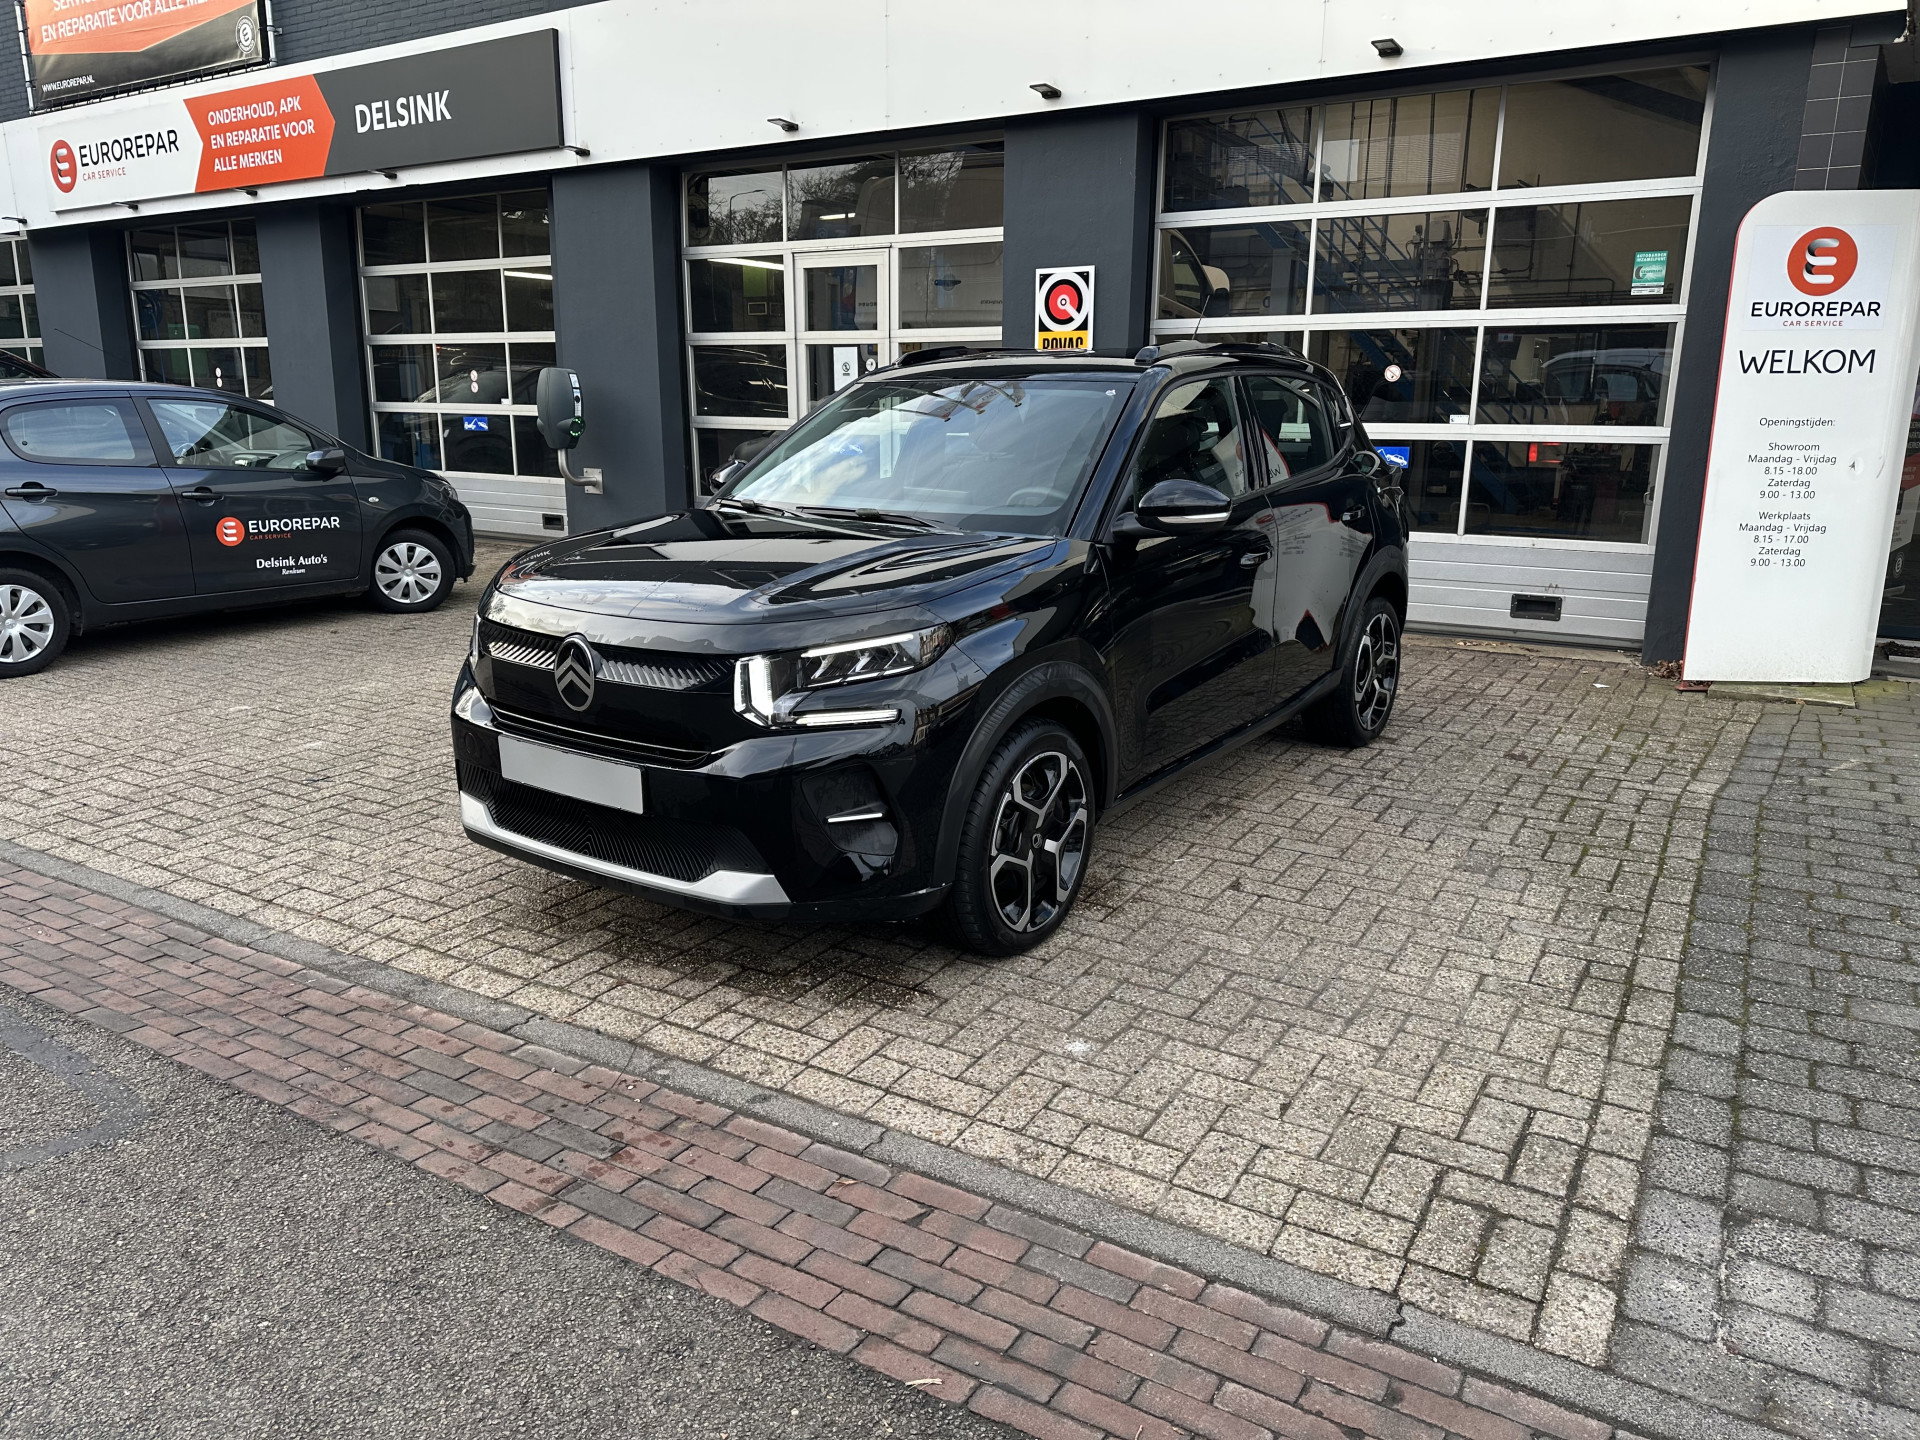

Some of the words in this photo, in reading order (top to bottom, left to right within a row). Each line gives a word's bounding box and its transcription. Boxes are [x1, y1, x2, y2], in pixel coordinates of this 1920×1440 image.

[42, 26, 58, 43] EN
[58, 9, 119, 40] REPARATIE
[119, 1, 151, 25] VOOR
[208, 101, 278, 126] ONDERHOUD,
[280, 95, 302, 114] APK
[354, 89, 452, 134] DELSINK
[210, 133, 225, 149] EN
[226, 124, 281, 147] REPARATIE
[282, 118, 316, 138] VOOR
[79, 129, 180, 167] EUROREPAR
[214, 155, 238, 172] ALLE
[239, 149, 283, 169] MERKEN
[82, 171, 96, 181] CAR
[98, 167, 127, 180] SERVICE
[1750, 301, 1881, 317] EUROREPAR
[1739, 349, 1876, 374] WELKOM
[1759, 417, 1836, 429] Openingstijden:
[1768, 442, 1820, 451] Showroom
[1747, 454, 1793, 465] Maandag
[1803, 454, 1837, 465] Vrijdag
[1764, 466, 1784, 475] 8.15
[1767, 478, 1811, 489] Zaterdag
[1759, 490, 1780, 499] 9.00
[1790, 490, 1816, 499] 13.00
[1758, 511, 1811, 521] Werkplaats
[248, 516, 341, 533] EUROREPAR
[1739, 523, 1783, 534] Maandag
[1793, 523, 1827, 534] Vrijdag
[264, 532, 292, 540] SERVICE
[1753, 535, 1773, 543] 8.15
[1784, 535, 1809, 543] 17.00
[1758, 546, 1801, 557] Zaterdag
[256, 555, 296, 569] Delsink
[297, 554, 328, 566] Auto's
[1750, 558, 1770, 567] 9.00
[1780, 558, 1806, 567] 13.00
